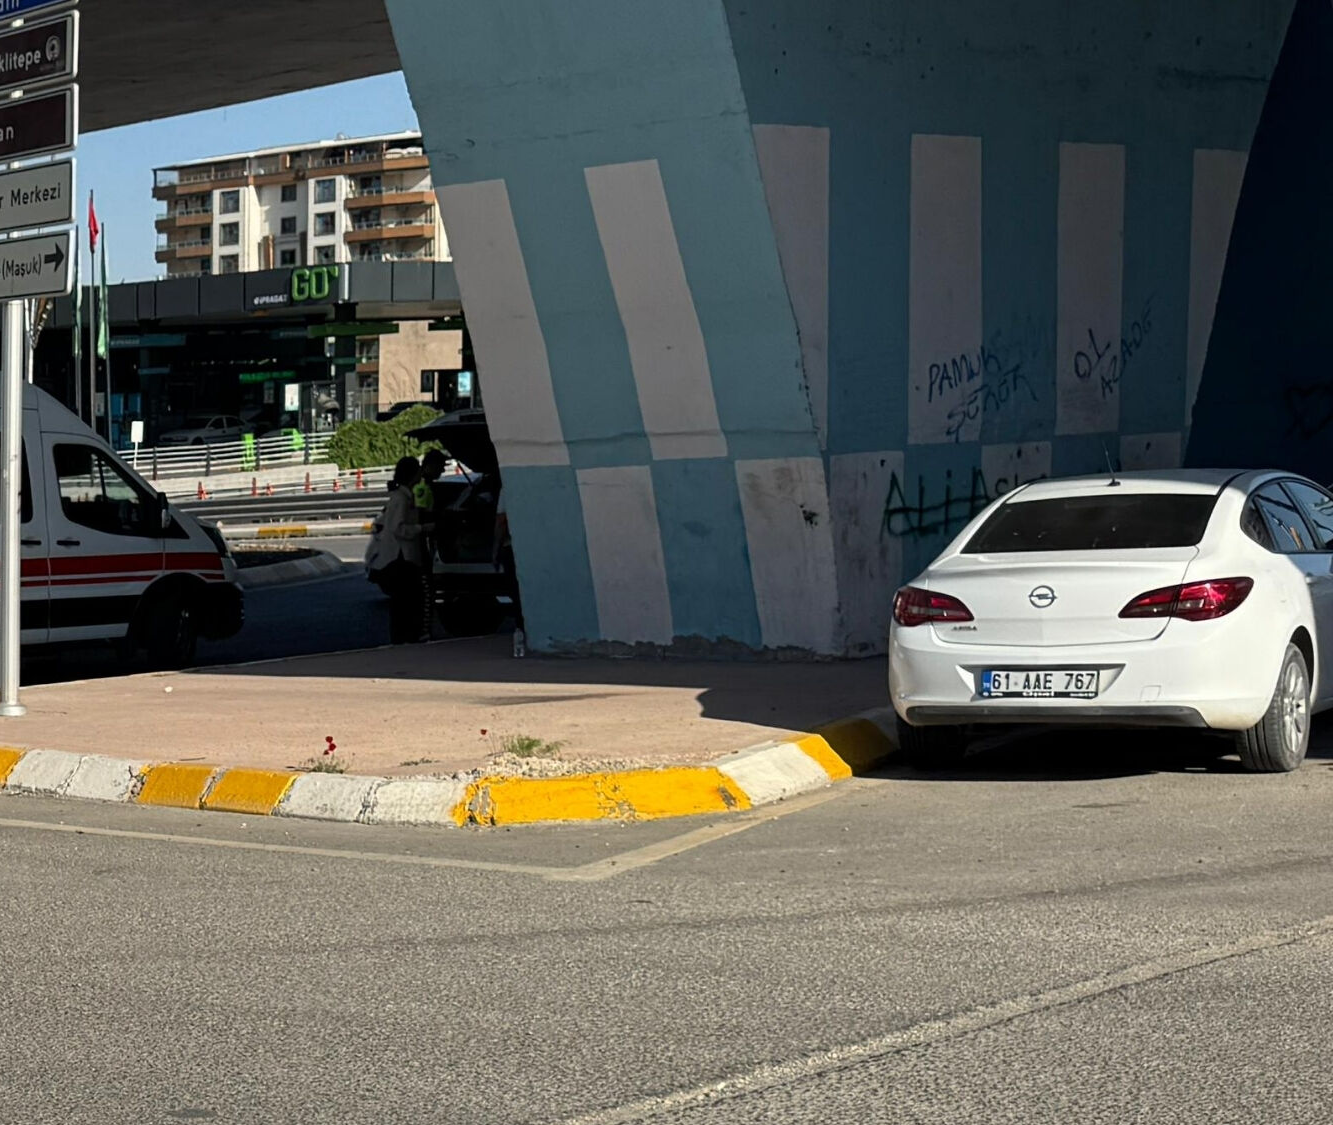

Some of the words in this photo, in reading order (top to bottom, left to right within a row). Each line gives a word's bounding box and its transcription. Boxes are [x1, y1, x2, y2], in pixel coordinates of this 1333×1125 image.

[10, 183, 61, 209] Merkezi
[927, 345, 1001, 404] PAMUK
[993, 673, 1010, 690] 61
[1023, 673, 1053, 690] AAE
[1064, 673, 1095, 690] 767
